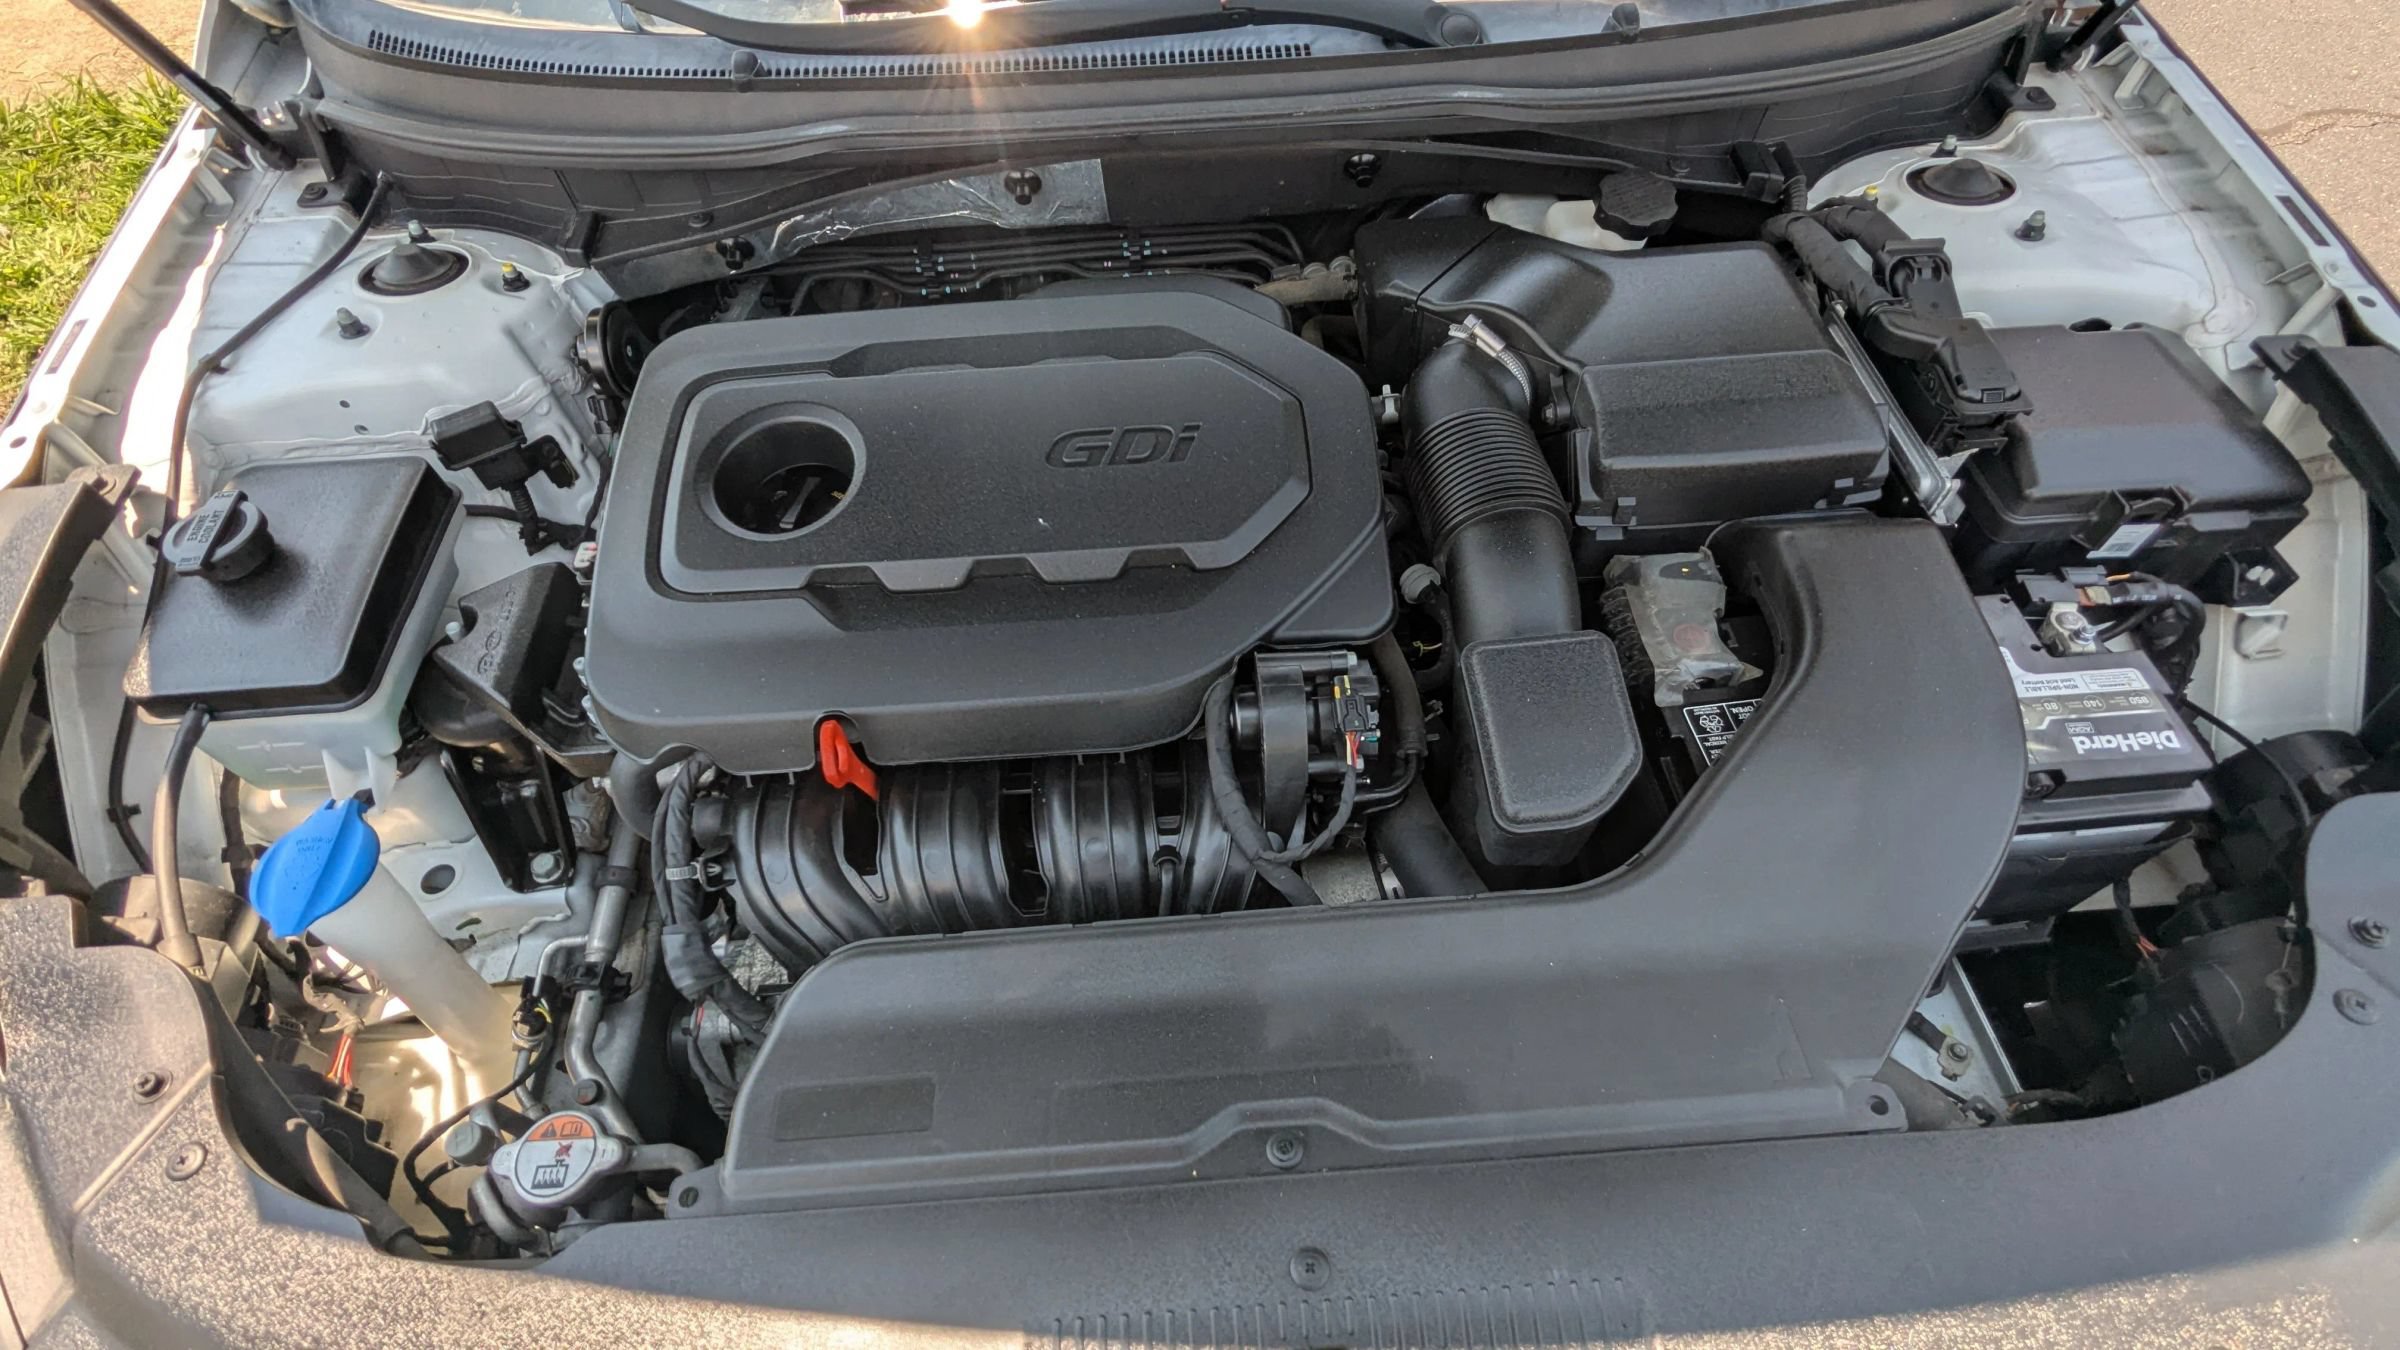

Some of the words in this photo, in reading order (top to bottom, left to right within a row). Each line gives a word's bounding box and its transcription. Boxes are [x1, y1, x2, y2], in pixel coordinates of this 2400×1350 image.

[1045, 422, 1202, 468] GDi
[187, 513, 210, 542] ENGINE
[198, 510, 224, 543] COOLANT
[2083, 699, 2103, 708] 140
[2072, 731, 2181, 754] DieHard
